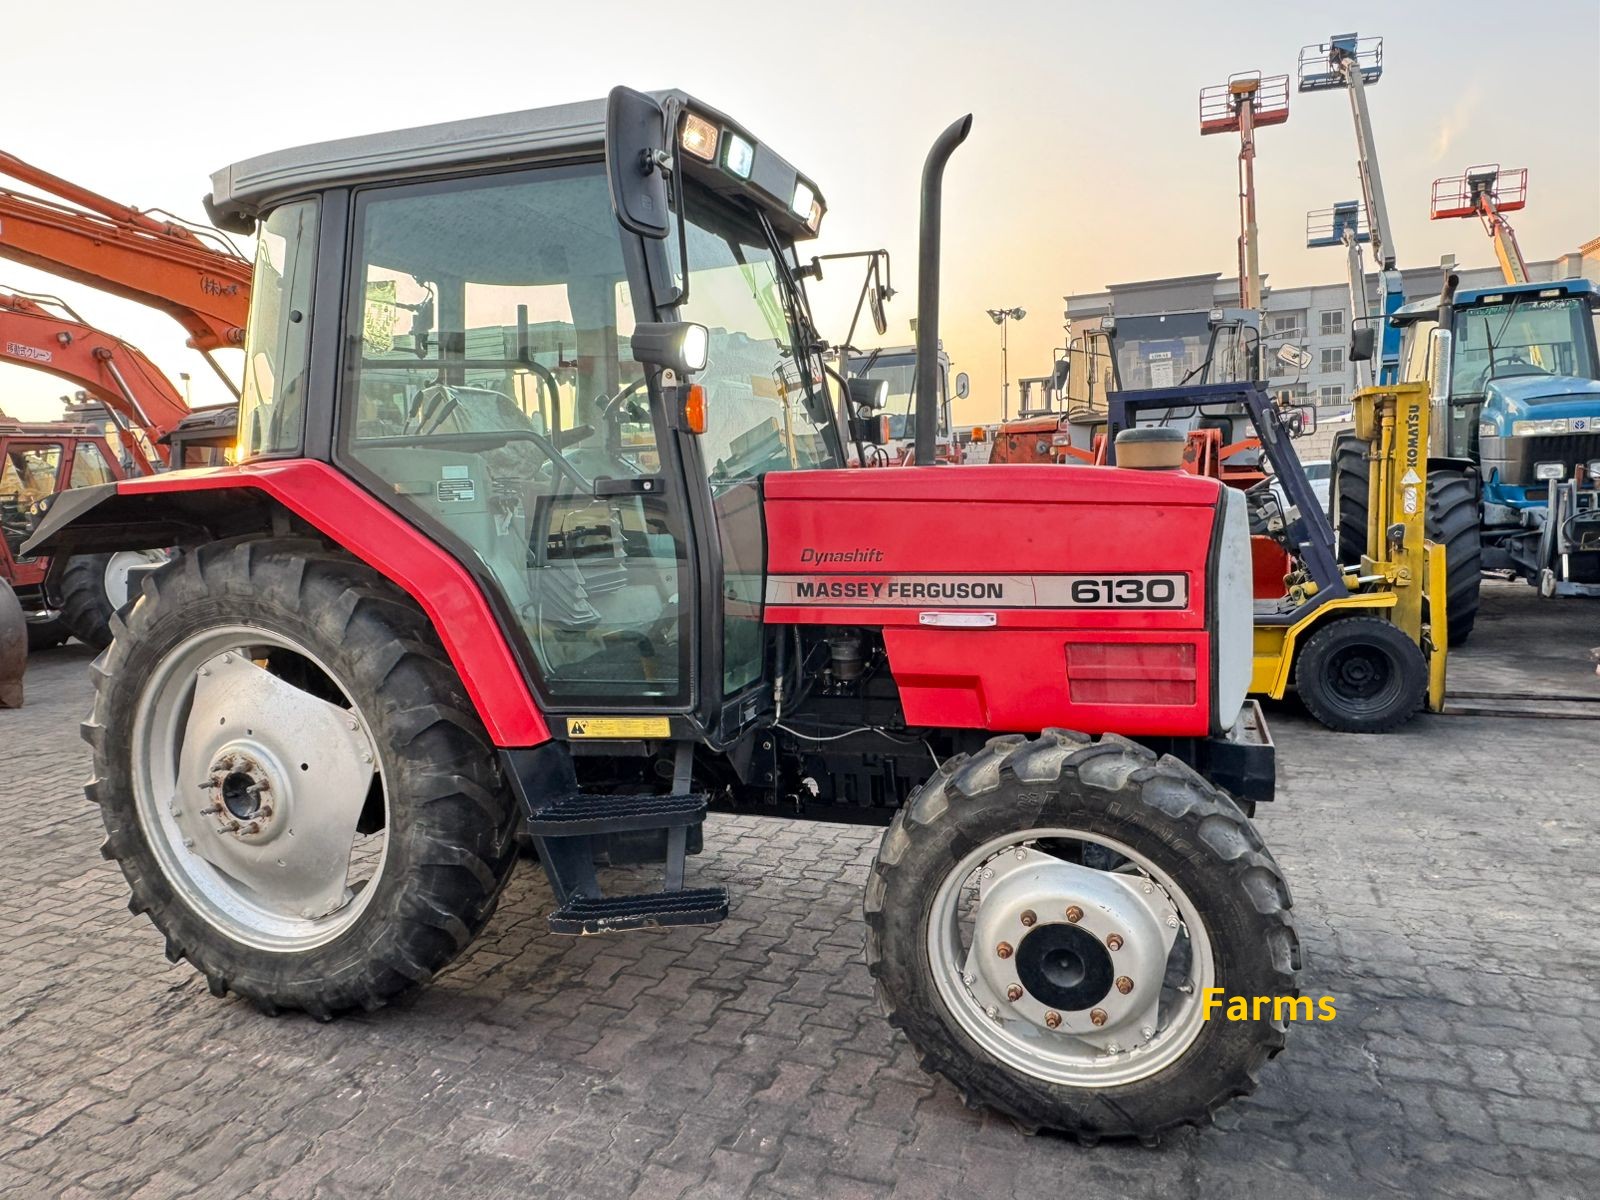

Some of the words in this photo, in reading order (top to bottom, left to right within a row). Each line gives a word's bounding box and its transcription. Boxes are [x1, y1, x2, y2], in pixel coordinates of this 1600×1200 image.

[1406, 404, 1420, 468] KOMATSU
[801, 548, 884, 566] Dynashift
[796, 582, 883, 598] MASSEY
[888, 582, 1003, 599] FERGUSON
[1071, 579, 1175, 603] 6130
